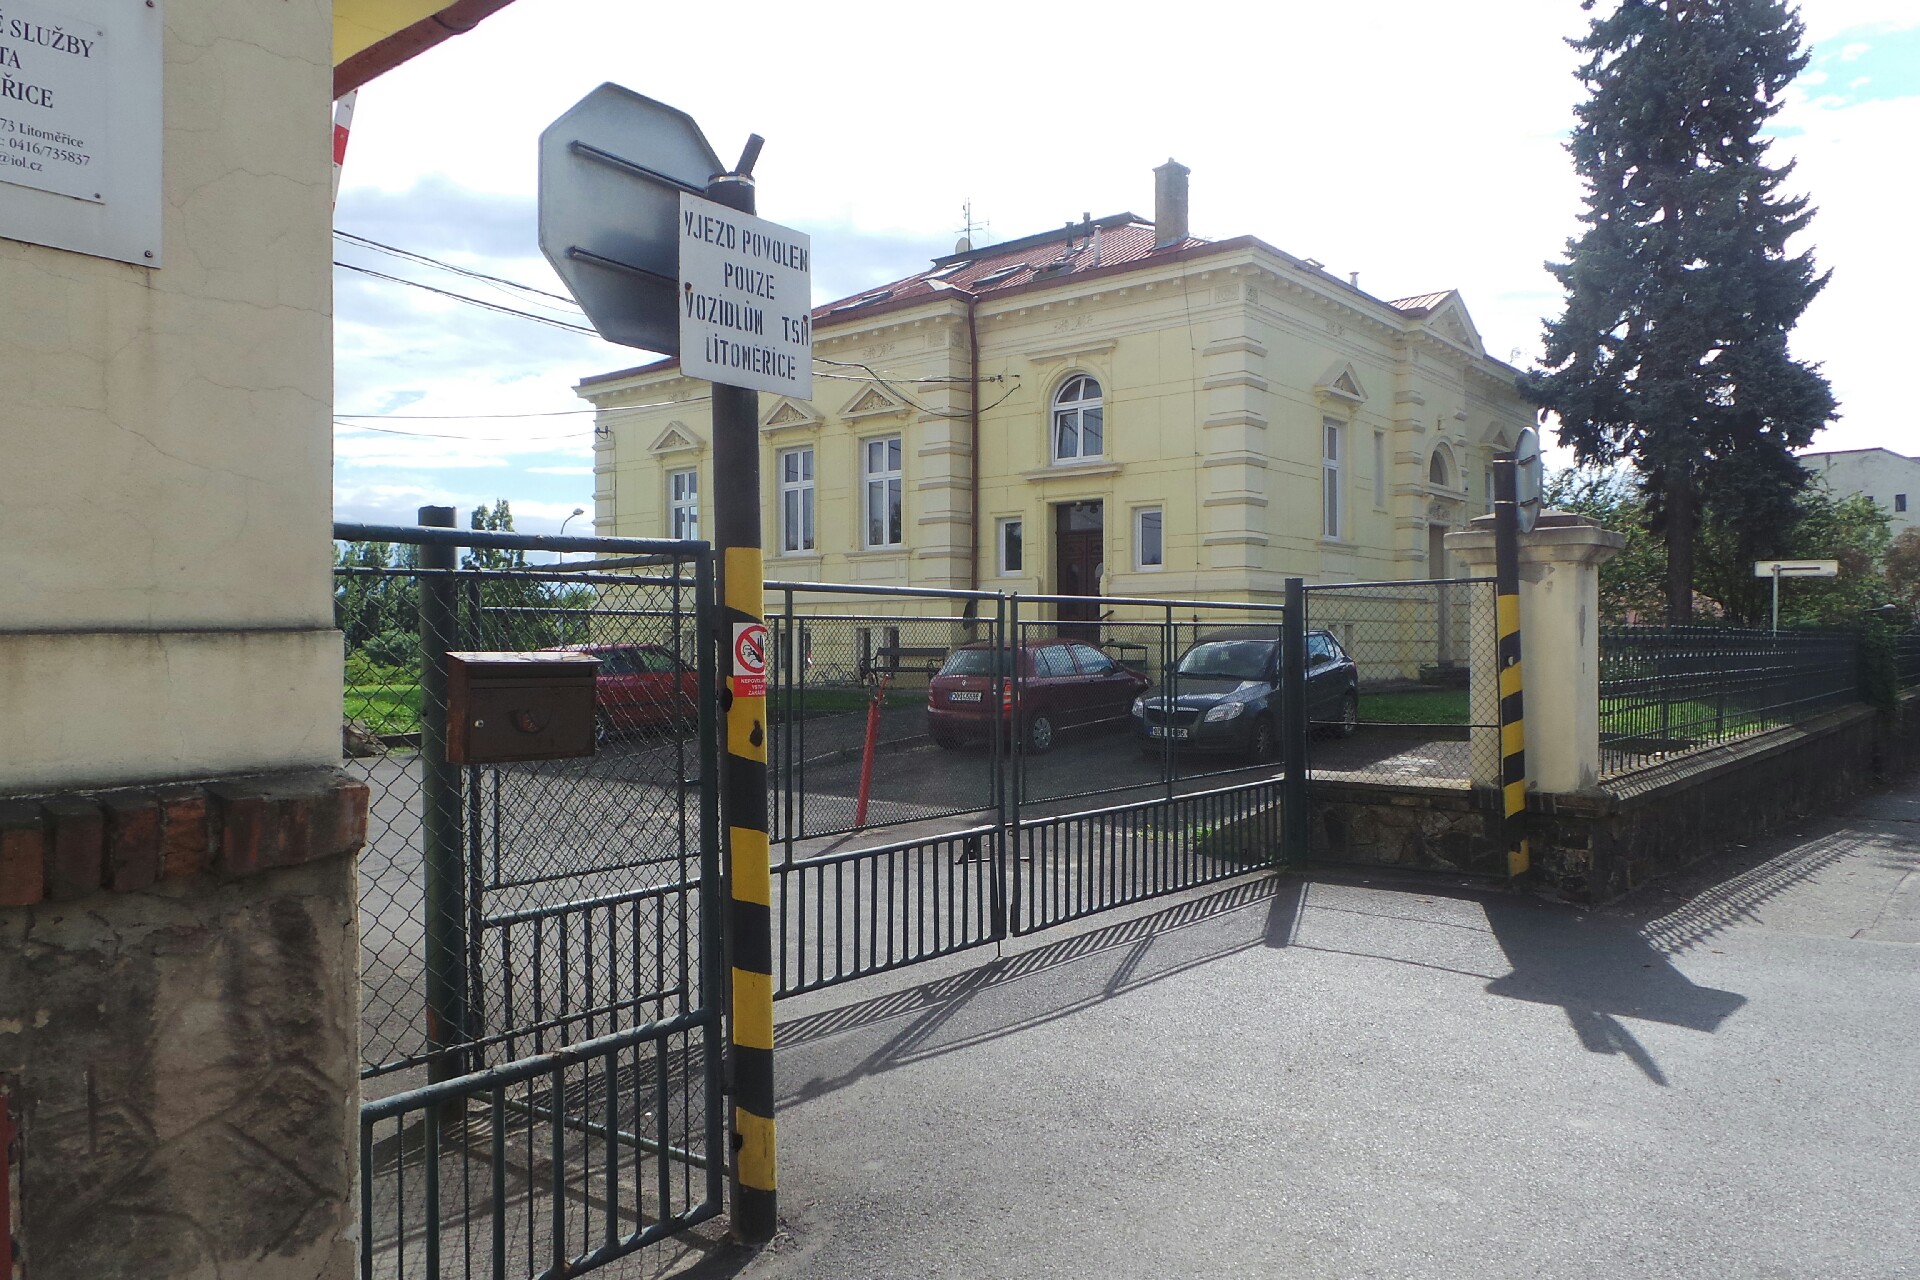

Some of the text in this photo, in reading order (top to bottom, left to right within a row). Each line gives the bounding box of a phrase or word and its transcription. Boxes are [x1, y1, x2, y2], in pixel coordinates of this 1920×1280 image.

[10, 19, 94, 59] SLUŽBY
[1, 71, 54, 109] ŘICE
[9, 137, 91, 166] 0416/735837
[19, 122, 84, 148] Litoměřice
[684, 210, 808, 273] VJEZD POVOLEN
[724, 262, 775, 300] POUZE
